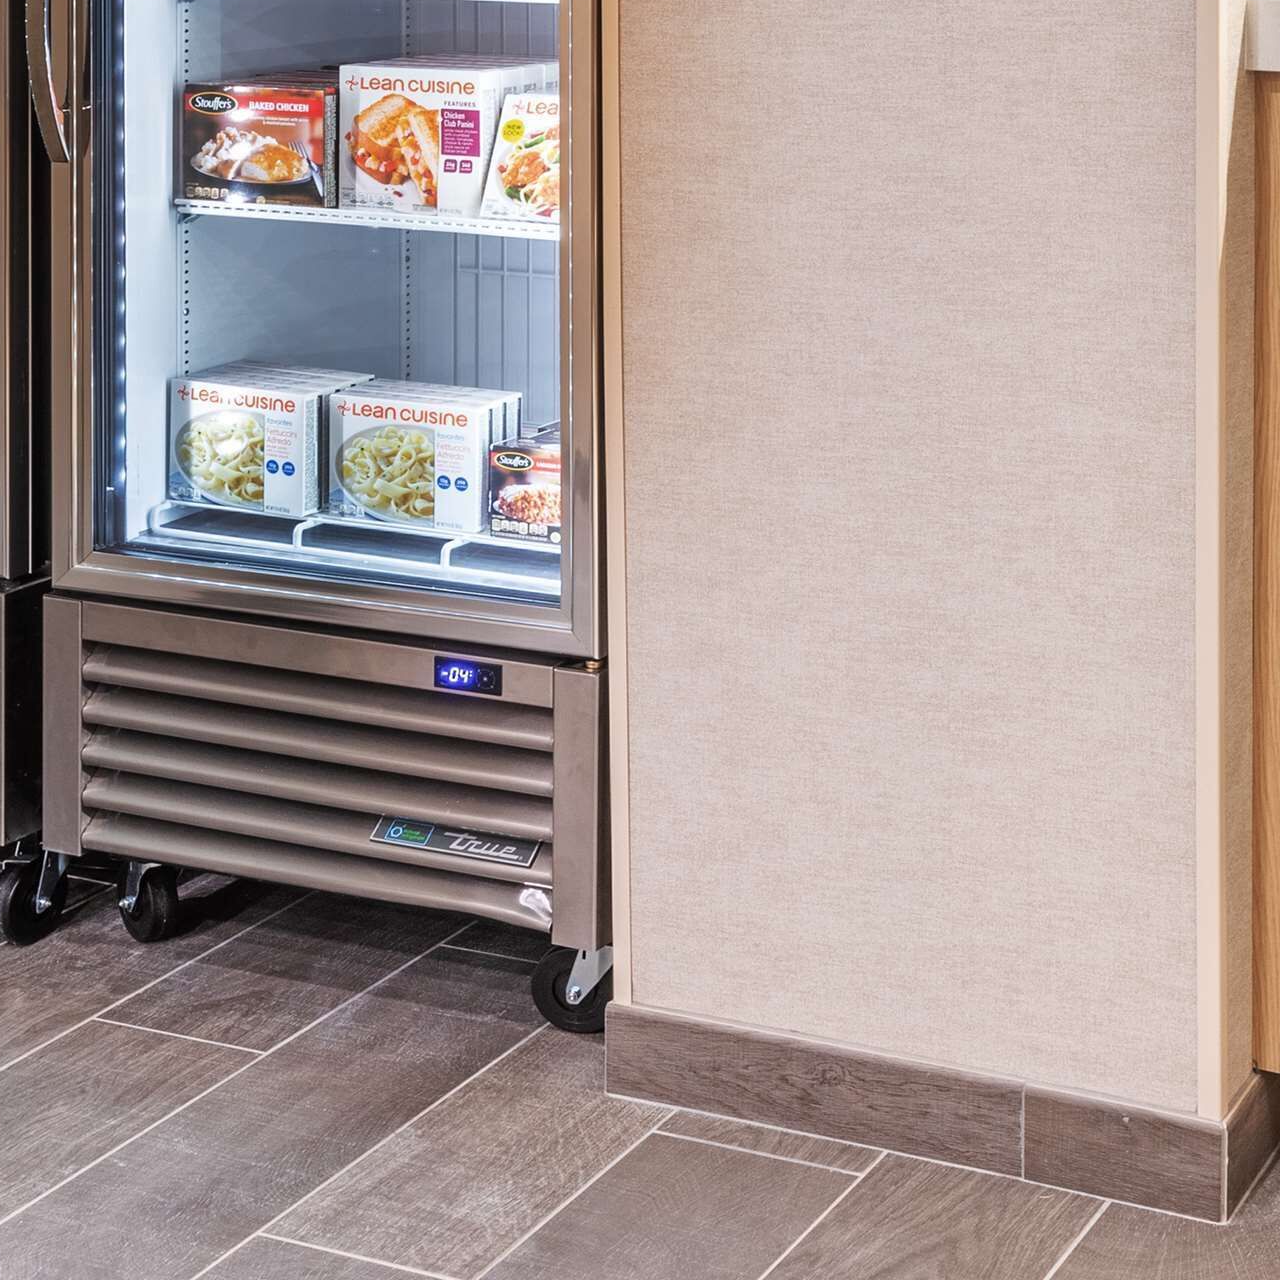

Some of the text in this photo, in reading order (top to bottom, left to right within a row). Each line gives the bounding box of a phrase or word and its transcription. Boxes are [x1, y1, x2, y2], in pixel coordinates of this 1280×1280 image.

[360, 76, 475, 95] Lean cuisine
[195, 96, 232, 110] Stouffer's
[248, 101, 310, 113] BAKED CHICKEN
[444, 111, 465, 119] Chicken
[444, 120, 474, 128] Club Panini
[352, 404, 468, 428] Lean cuisine
[498, 455, 529, 468] Stouffer's
